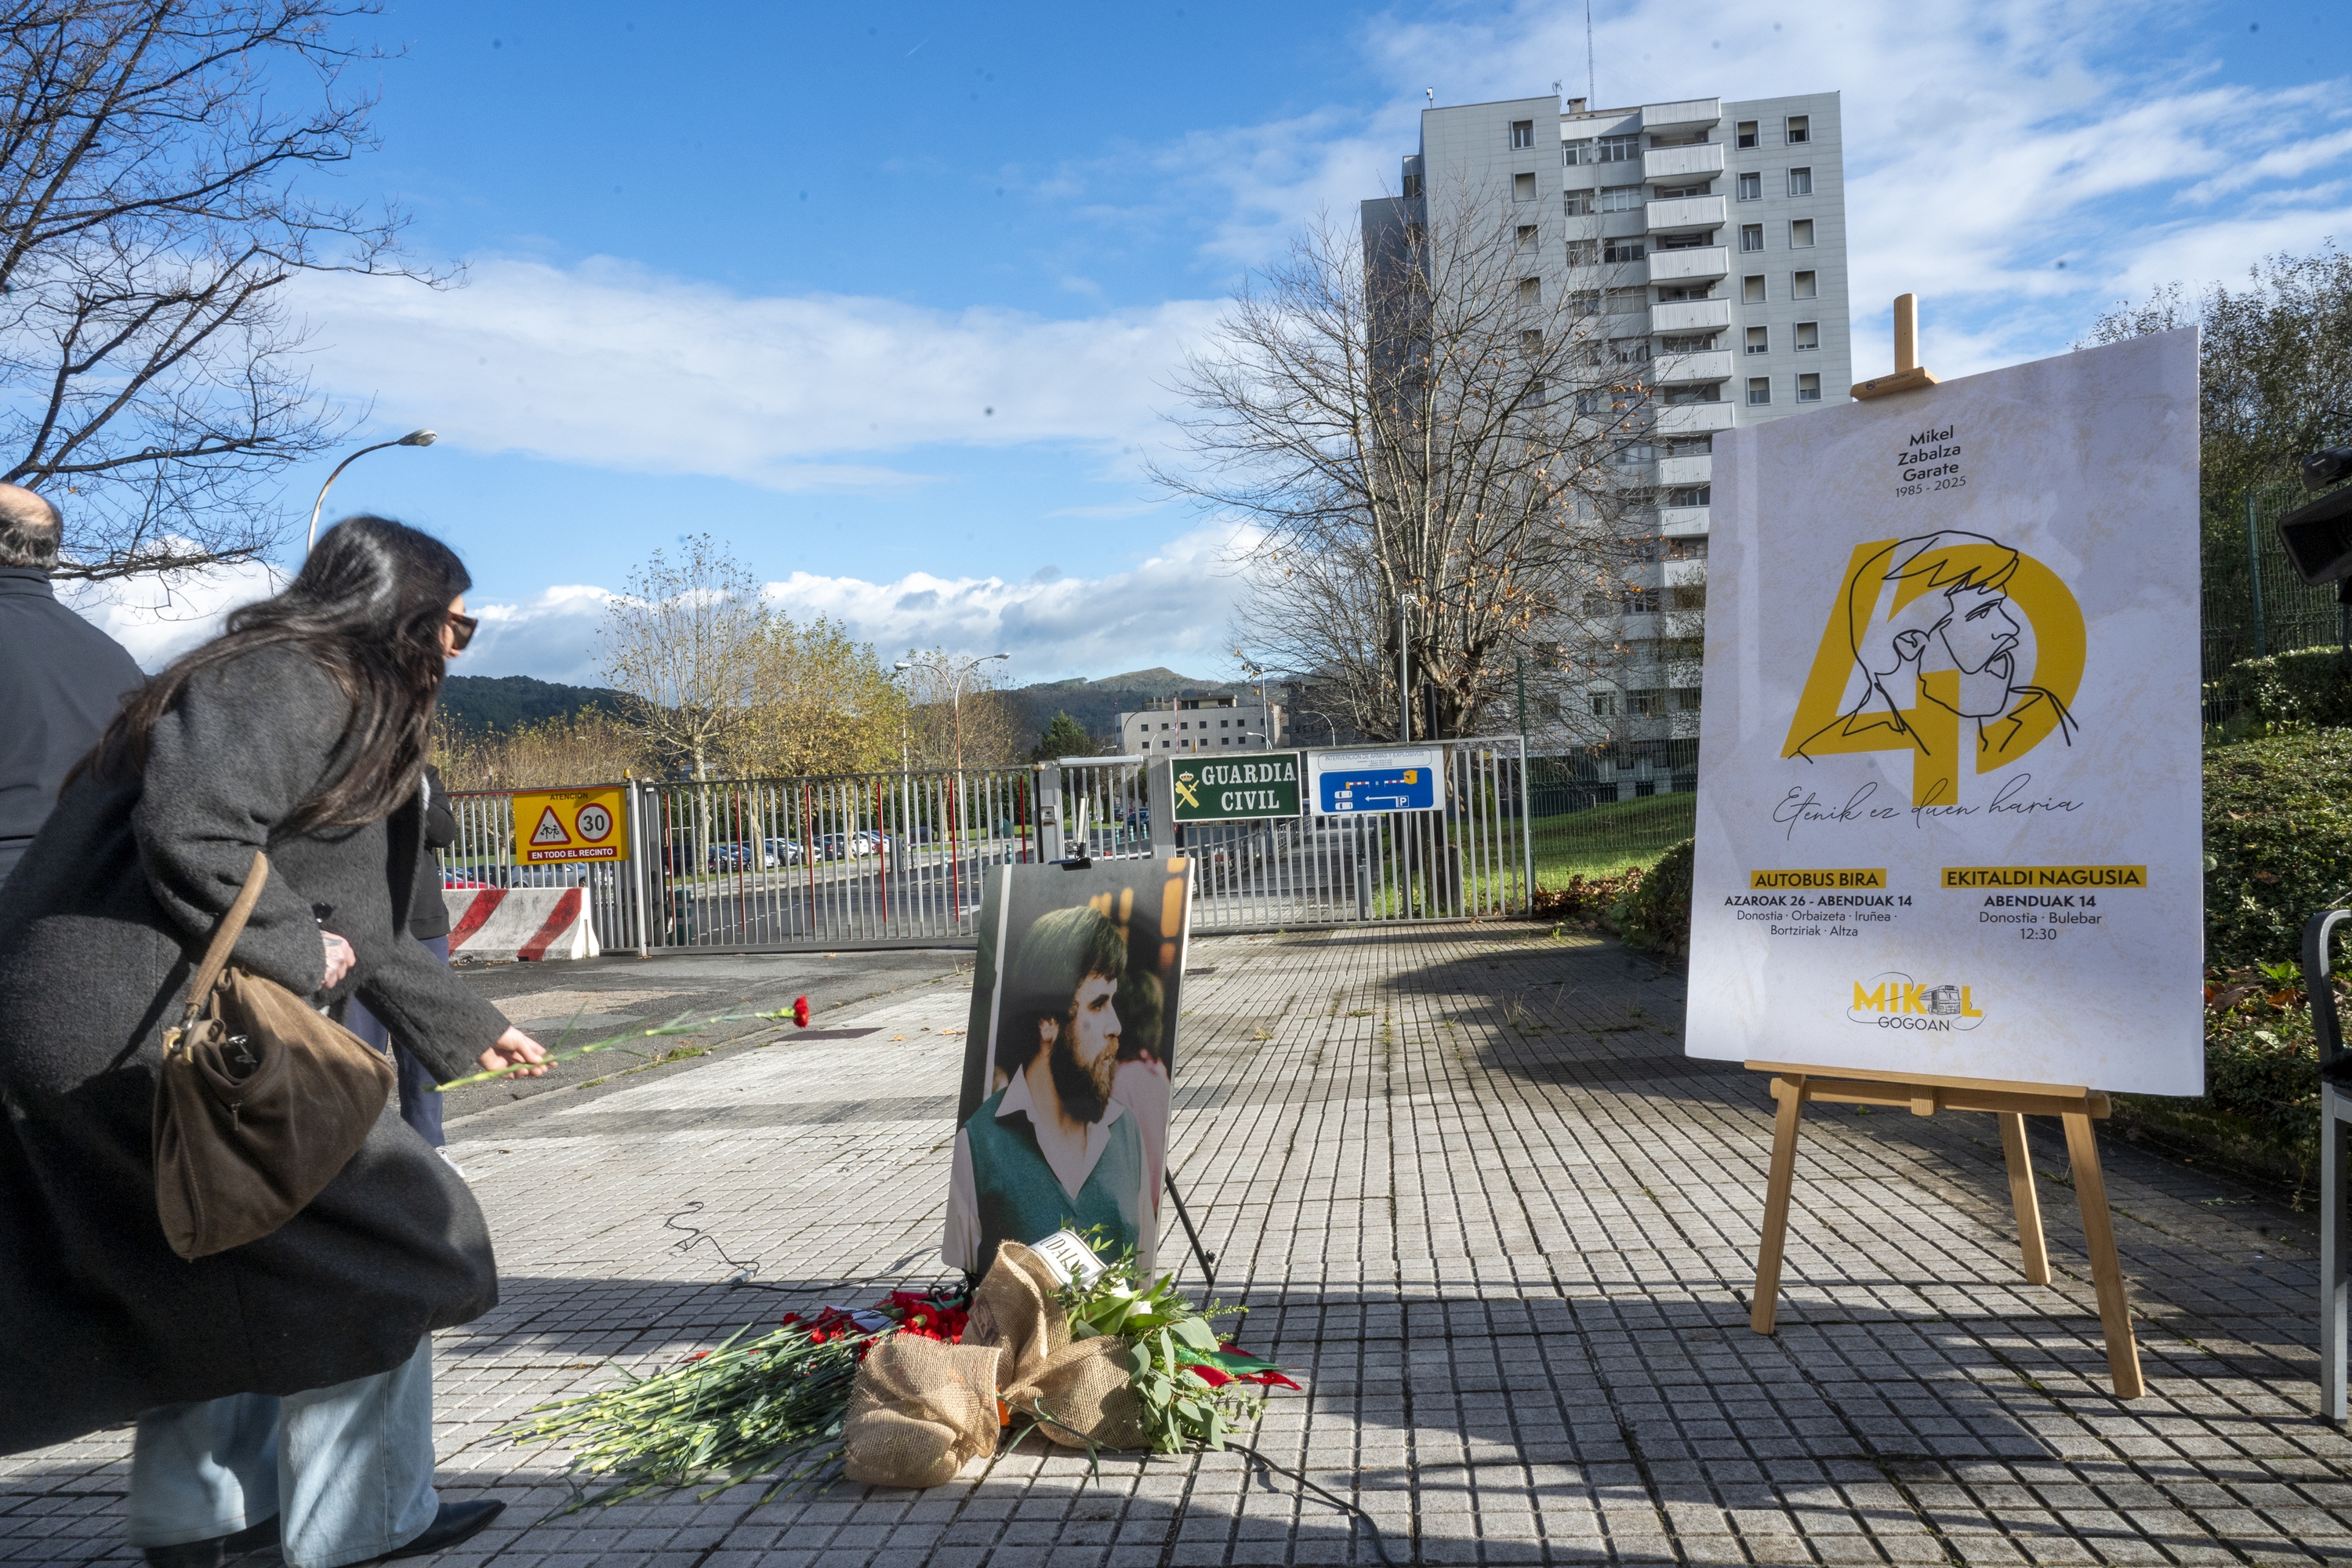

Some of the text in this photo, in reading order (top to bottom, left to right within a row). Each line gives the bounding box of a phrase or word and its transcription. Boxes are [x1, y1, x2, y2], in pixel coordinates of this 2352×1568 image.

[1909, 424, 1954, 447] Mikel
[1896, 445, 1961, 466] Zabalza
[1903, 463, 1959, 482] Garate
[1895, 484, 1922, 498] 1985
[1933, 475, 1966, 492] 2025
[1201, 762, 1297, 786] GUARDIA
[550, 791, 588, 800] ATENCIÓN
[1221, 789, 1279, 811] CIVIL
[1399, 797, 1407, 806] P
[1773, 773, 2084, 841] Etenik ez duen haria
[583, 815, 605, 832] 30
[544, 850, 566, 858] TODO
[579, 848, 613, 857] RECINTO
[1755, 872, 1879, 887] AUTOBUS BIRA
[1947, 869, 2140, 885] EKITALDI NAGUSIA
[1724, 895, 1788, 906] AZAROAK
[1790, 895, 1806, 906] 26
[1817, 895, 1895, 906] ABENDUAK
[1898, 895, 1913, 906] 14
[1984, 895, 2096, 907] ABENDUAK 14
[1737, 910, 1783, 920] Donostia
[1791, 910, 1846, 921] Orbaizeta
[1855, 911, 1891, 922] Iruñea
[1980, 911, 2038, 924] Donostia
[2049, 912, 2102, 924] Bulebar
[1770, 924, 1821, 936] Bortziriak
[1829, 925, 1858, 937] Altza
[2020, 928, 2057, 940] 12:30
[1853, 981, 1983, 1018] MIKL
[1878, 1016, 1950, 1032] GOGOAN
